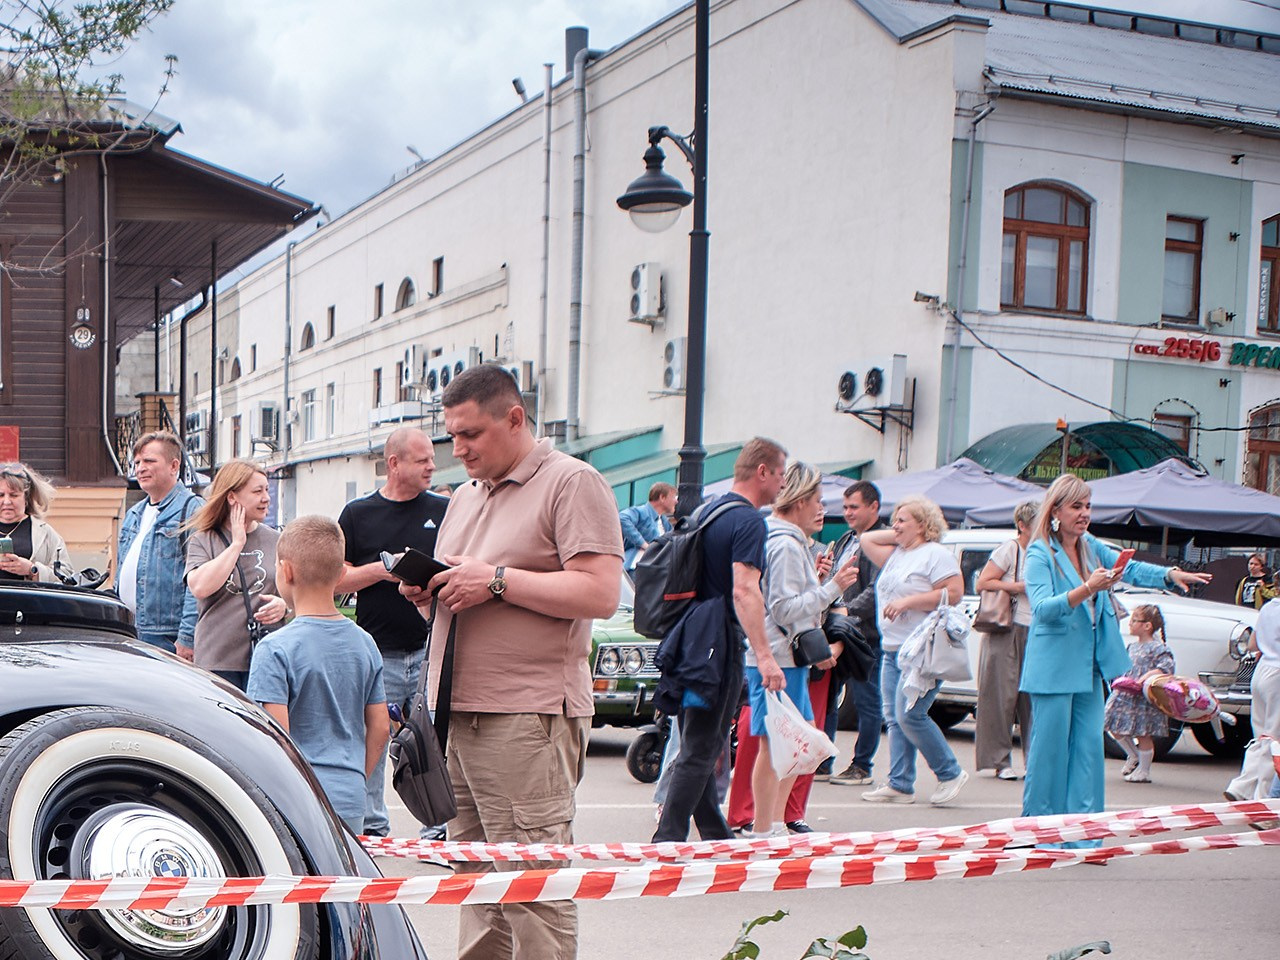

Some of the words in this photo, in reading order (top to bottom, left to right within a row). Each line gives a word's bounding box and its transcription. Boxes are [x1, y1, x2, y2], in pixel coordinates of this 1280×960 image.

[77, 329, 89, 340] 29
[1164, 337, 1221, 363] 255/6
[108, 740, 142, 752] ATLAS
[154, 854, 179, 868] BMW
